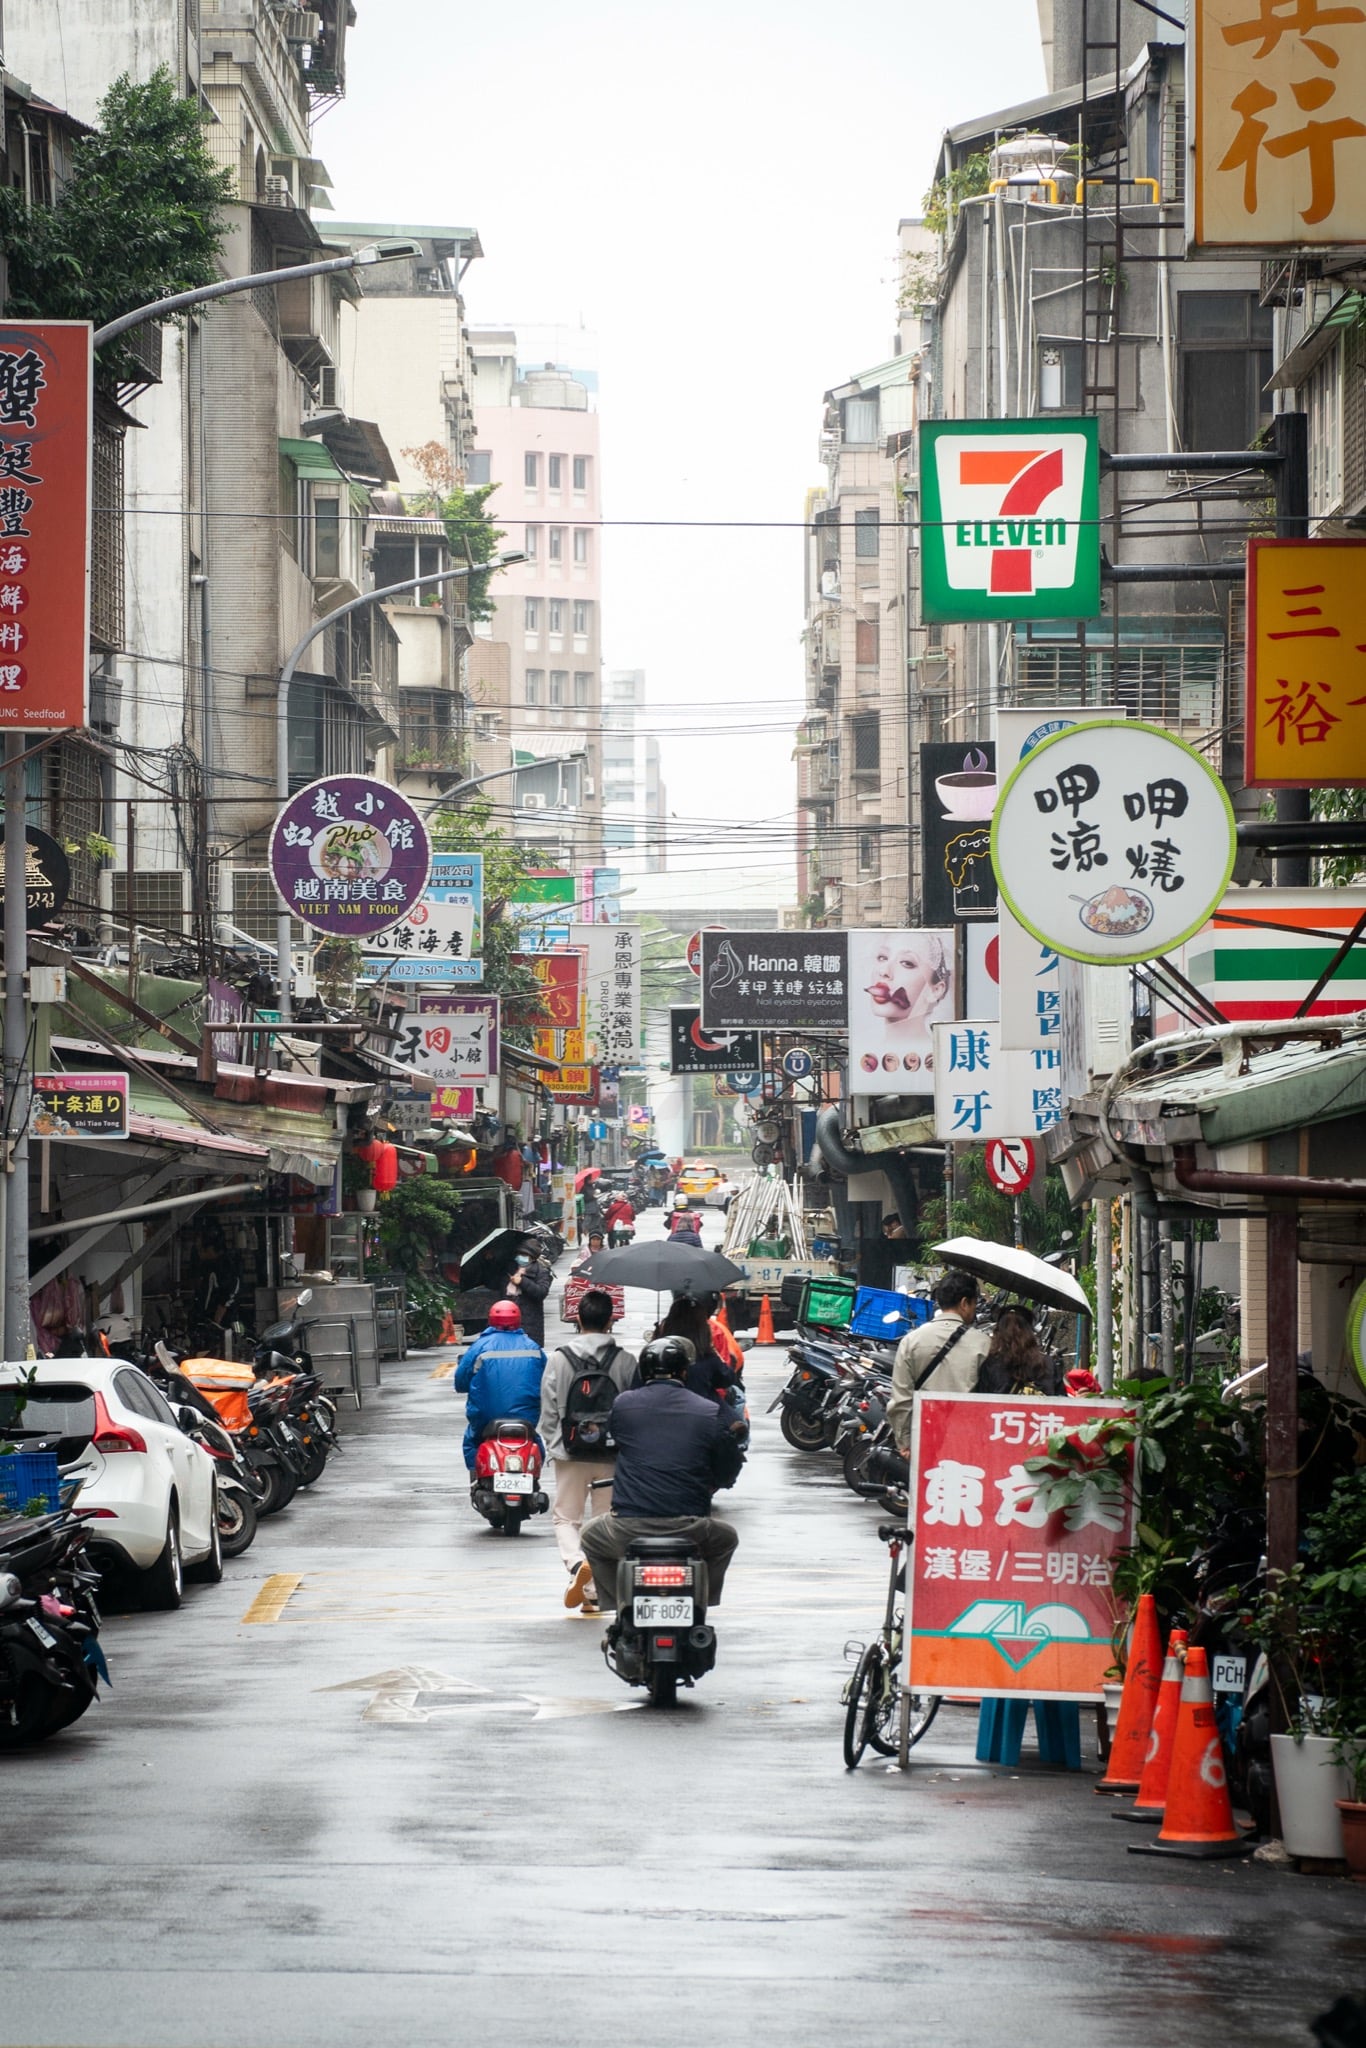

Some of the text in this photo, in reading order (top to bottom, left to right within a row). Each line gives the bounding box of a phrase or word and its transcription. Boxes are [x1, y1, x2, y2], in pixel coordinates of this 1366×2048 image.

[0, 545, 28, 692] 海鮮料理
[23, 708, 65, 719] Seedfood
[293, 878, 408, 901] 越南美食
[300, 904, 330, 915] VIET
[338, 904, 361, 915] NAM
[394, 965, 416, 977] (02)
[419, 965, 477, 977] 2507-4878
[738, 979, 767, 996] 美甲
[772, 979, 804, 996] 美睫
[756, 998, 843, 1008] Nail eyelash eyebrow
[569, 1030, 583, 1044] 24
[46, 1094, 121, 1114] 十条通り
[75, 1120, 120, 1129] Shi Tiao Tong
